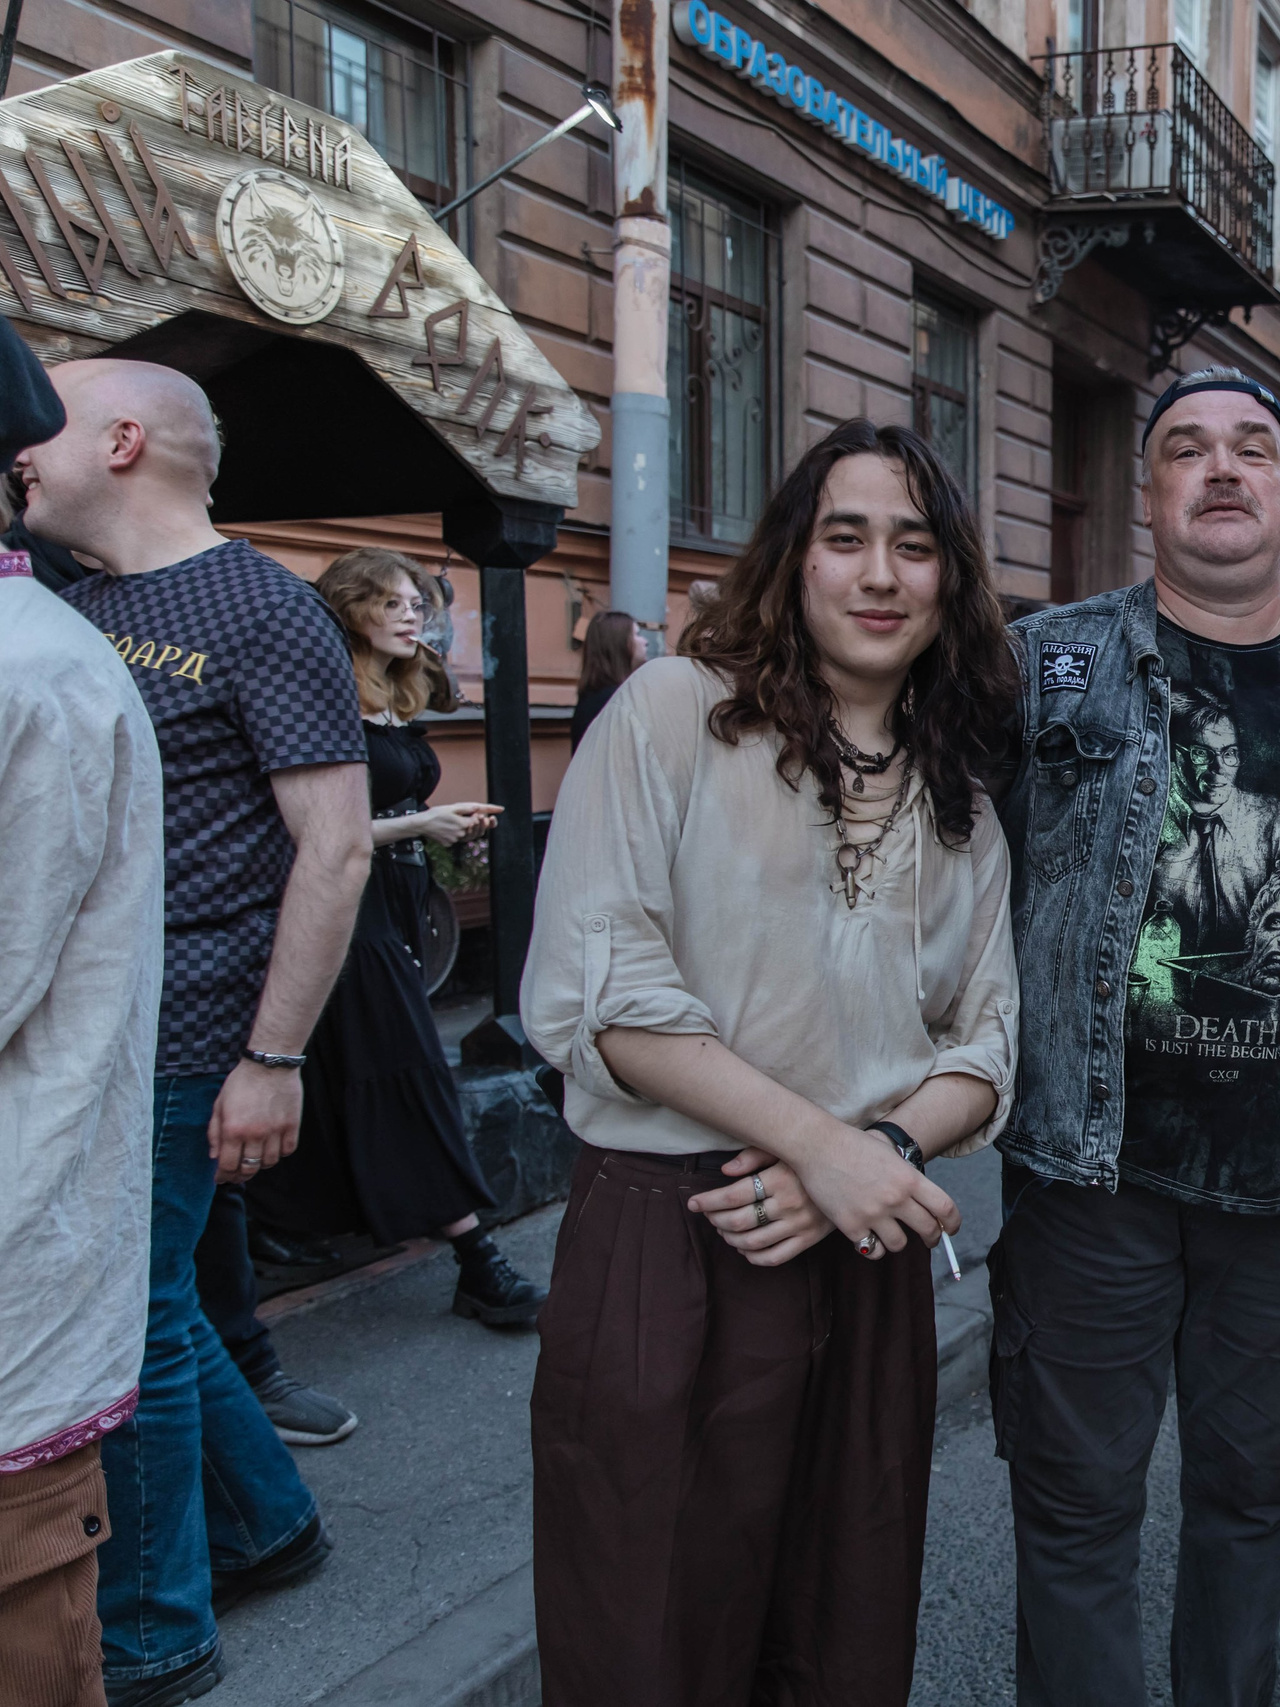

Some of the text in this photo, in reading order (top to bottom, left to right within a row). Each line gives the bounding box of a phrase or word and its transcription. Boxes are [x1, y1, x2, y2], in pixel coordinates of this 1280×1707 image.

[168, 64, 352, 192] ТАВЕРНА
[688, 0, 1015, 239] ОБРАЗОВАТЕЛЬНЫЙ ЦЕНТР
[1043, 645, 1093, 655] АНАРХИЯ
[1174, 1014, 1279, 1046] DEATH
[1145, 1038, 1157, 1051] IS
[1160, 1040, 1193, 1055] JUST
[1197, 1043, 1227, 1058] THE
